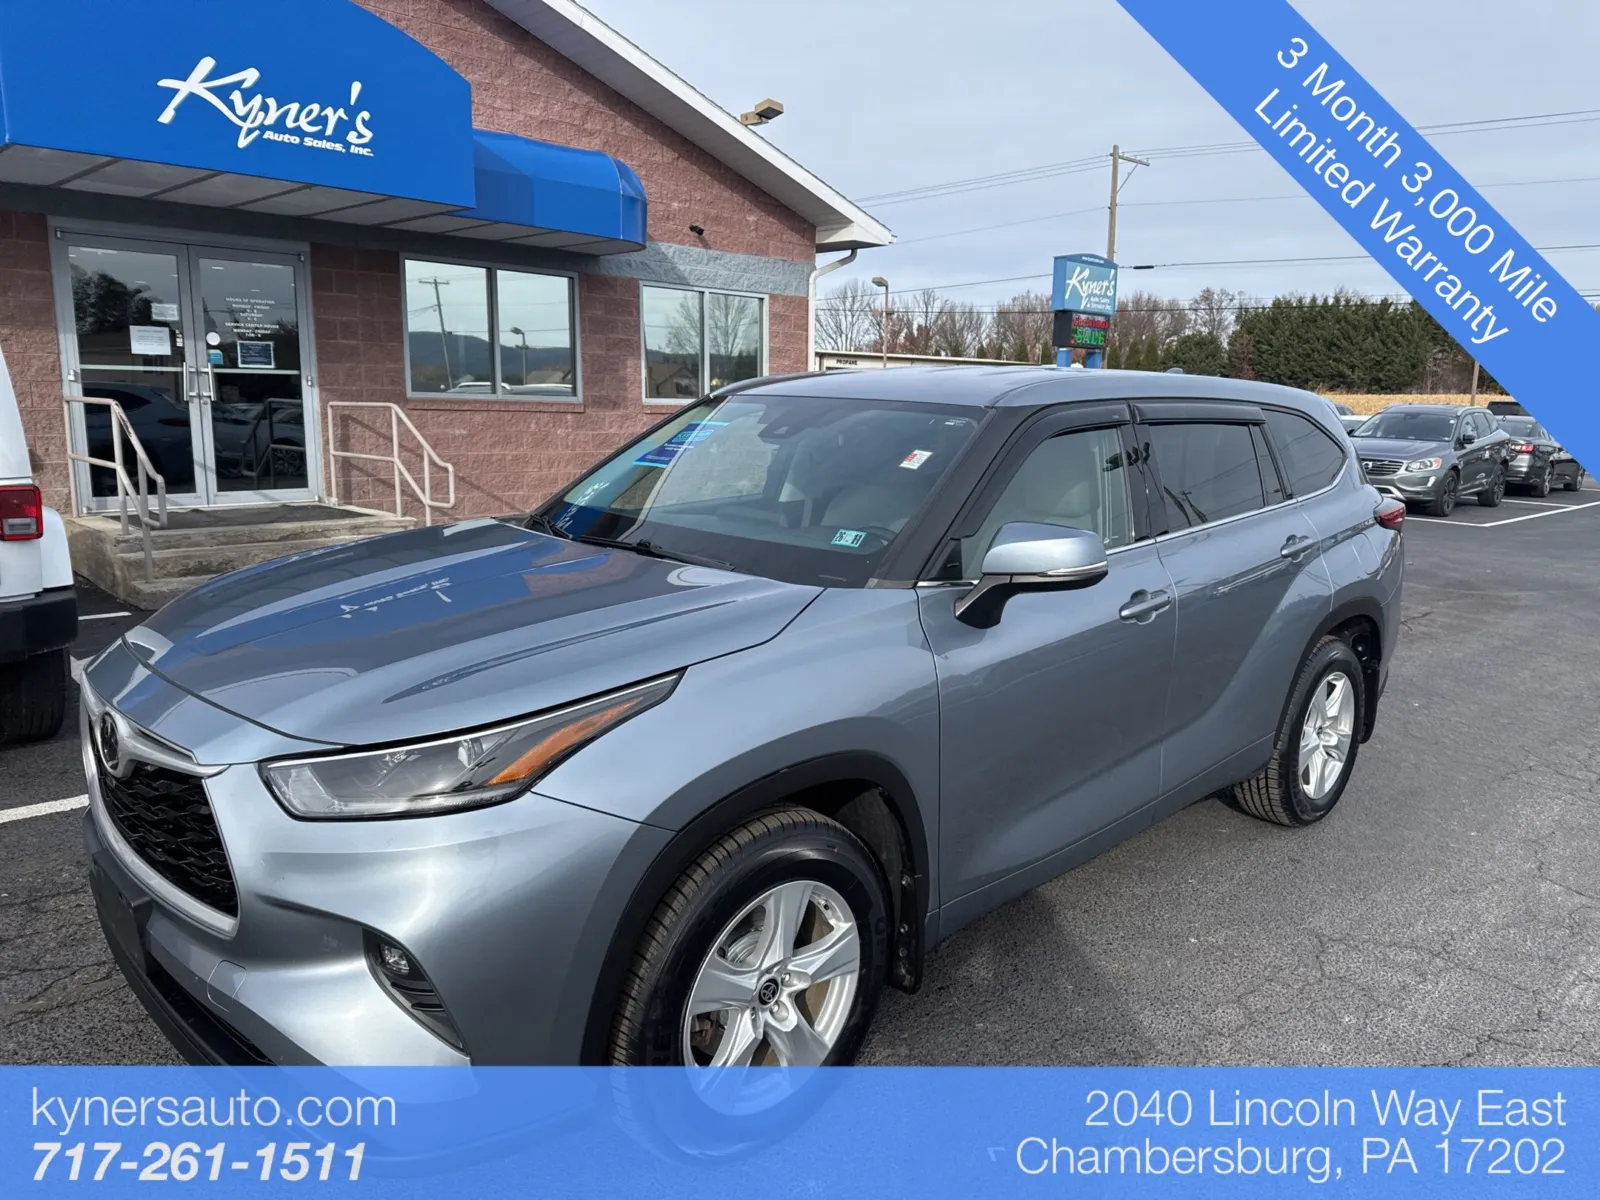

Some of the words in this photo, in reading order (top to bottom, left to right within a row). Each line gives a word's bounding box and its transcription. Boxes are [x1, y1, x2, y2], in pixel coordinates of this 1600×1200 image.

[157, 56, 373, 149] Kyner's
[262, 130, 301, 146] Auto
[303, 136, 346, 153] Sales,
[349, 144, 375, 157] Inc.
[1065, 266, 1115, 309] Kyner's
[1076, 328, 1105, 345] SALE
